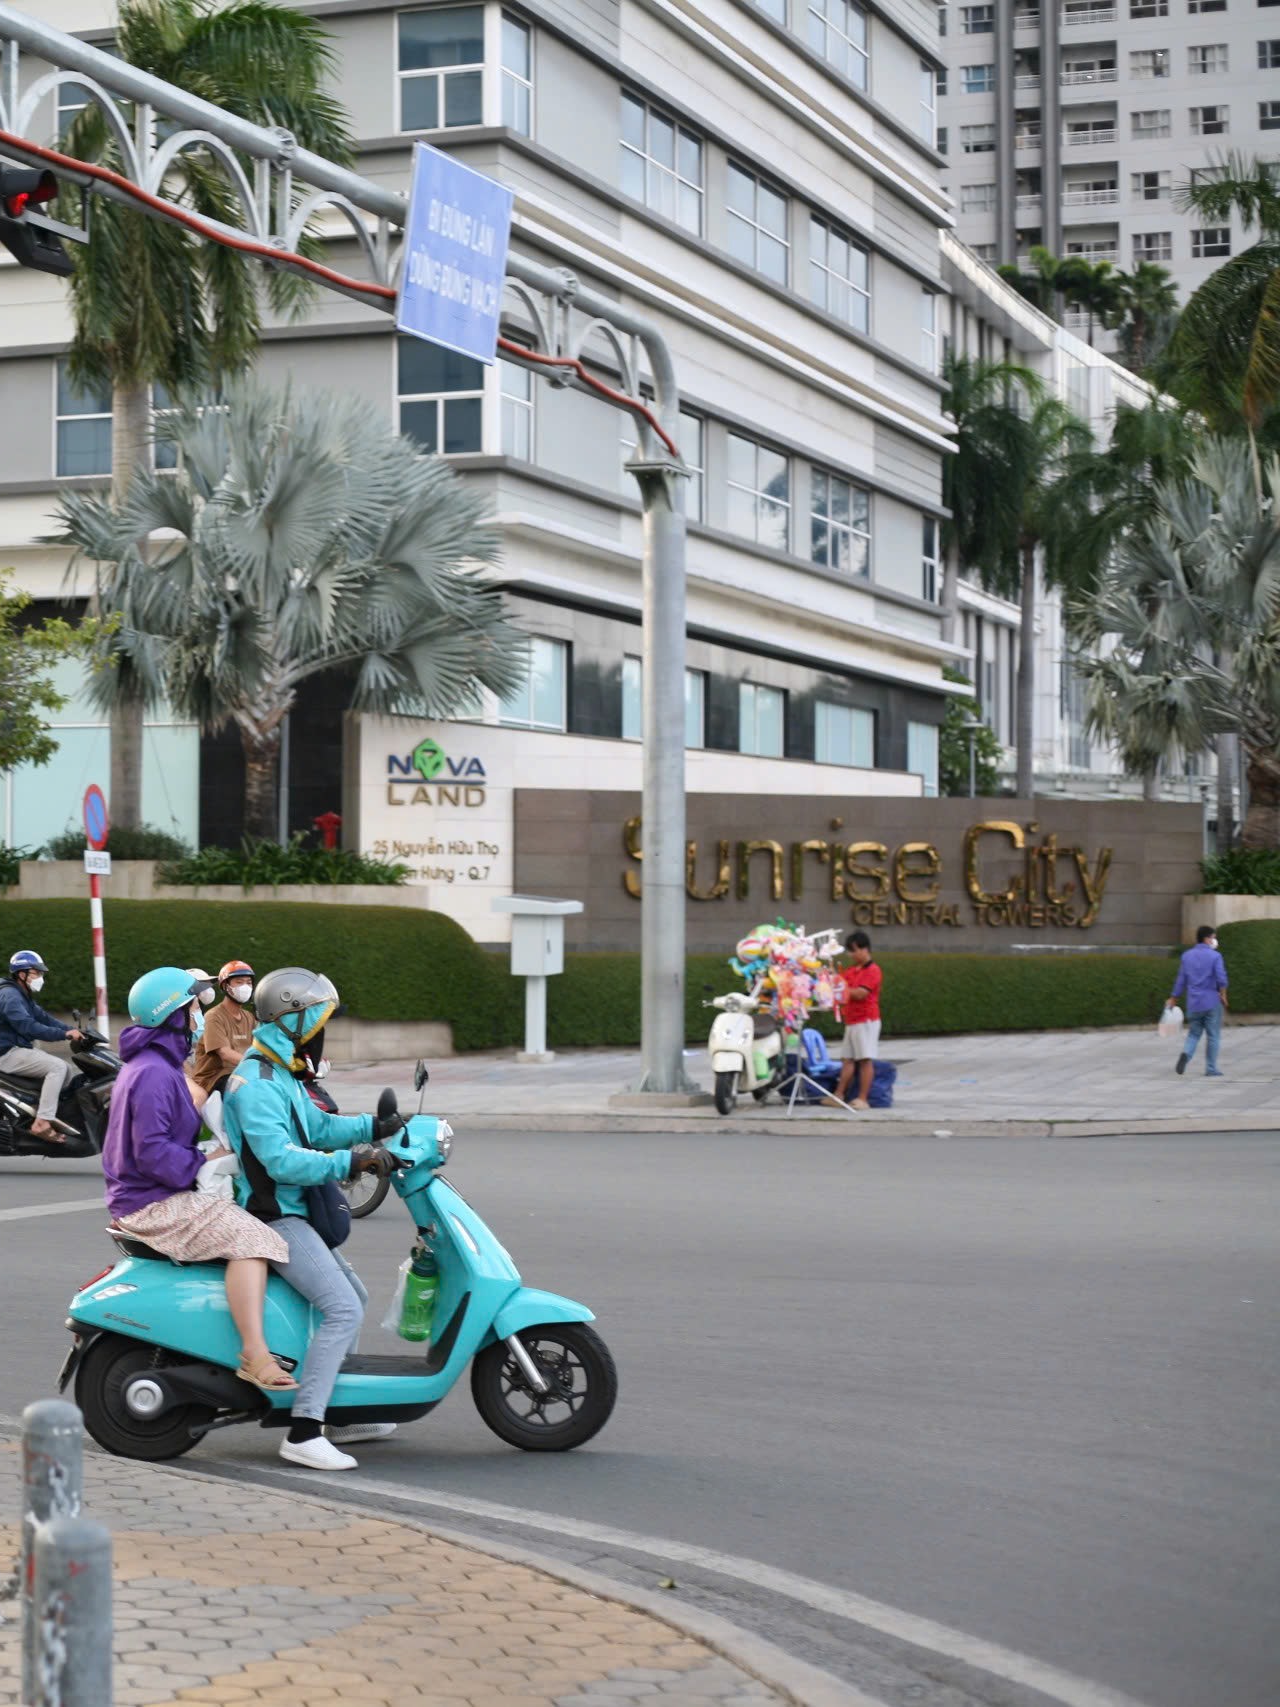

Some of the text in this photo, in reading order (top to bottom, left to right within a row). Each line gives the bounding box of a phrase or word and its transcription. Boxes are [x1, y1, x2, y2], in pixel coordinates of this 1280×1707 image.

[387, 783, 487, 807] LAND
[373, 840, 388, 855] 25
[392, 836, 445, 857] Nguyễn
[476, 840, 500, 859] Thọ
[965, 820, 1113, 928] City
[851, 902, 1078, 928] CENTRAL TOWERS
